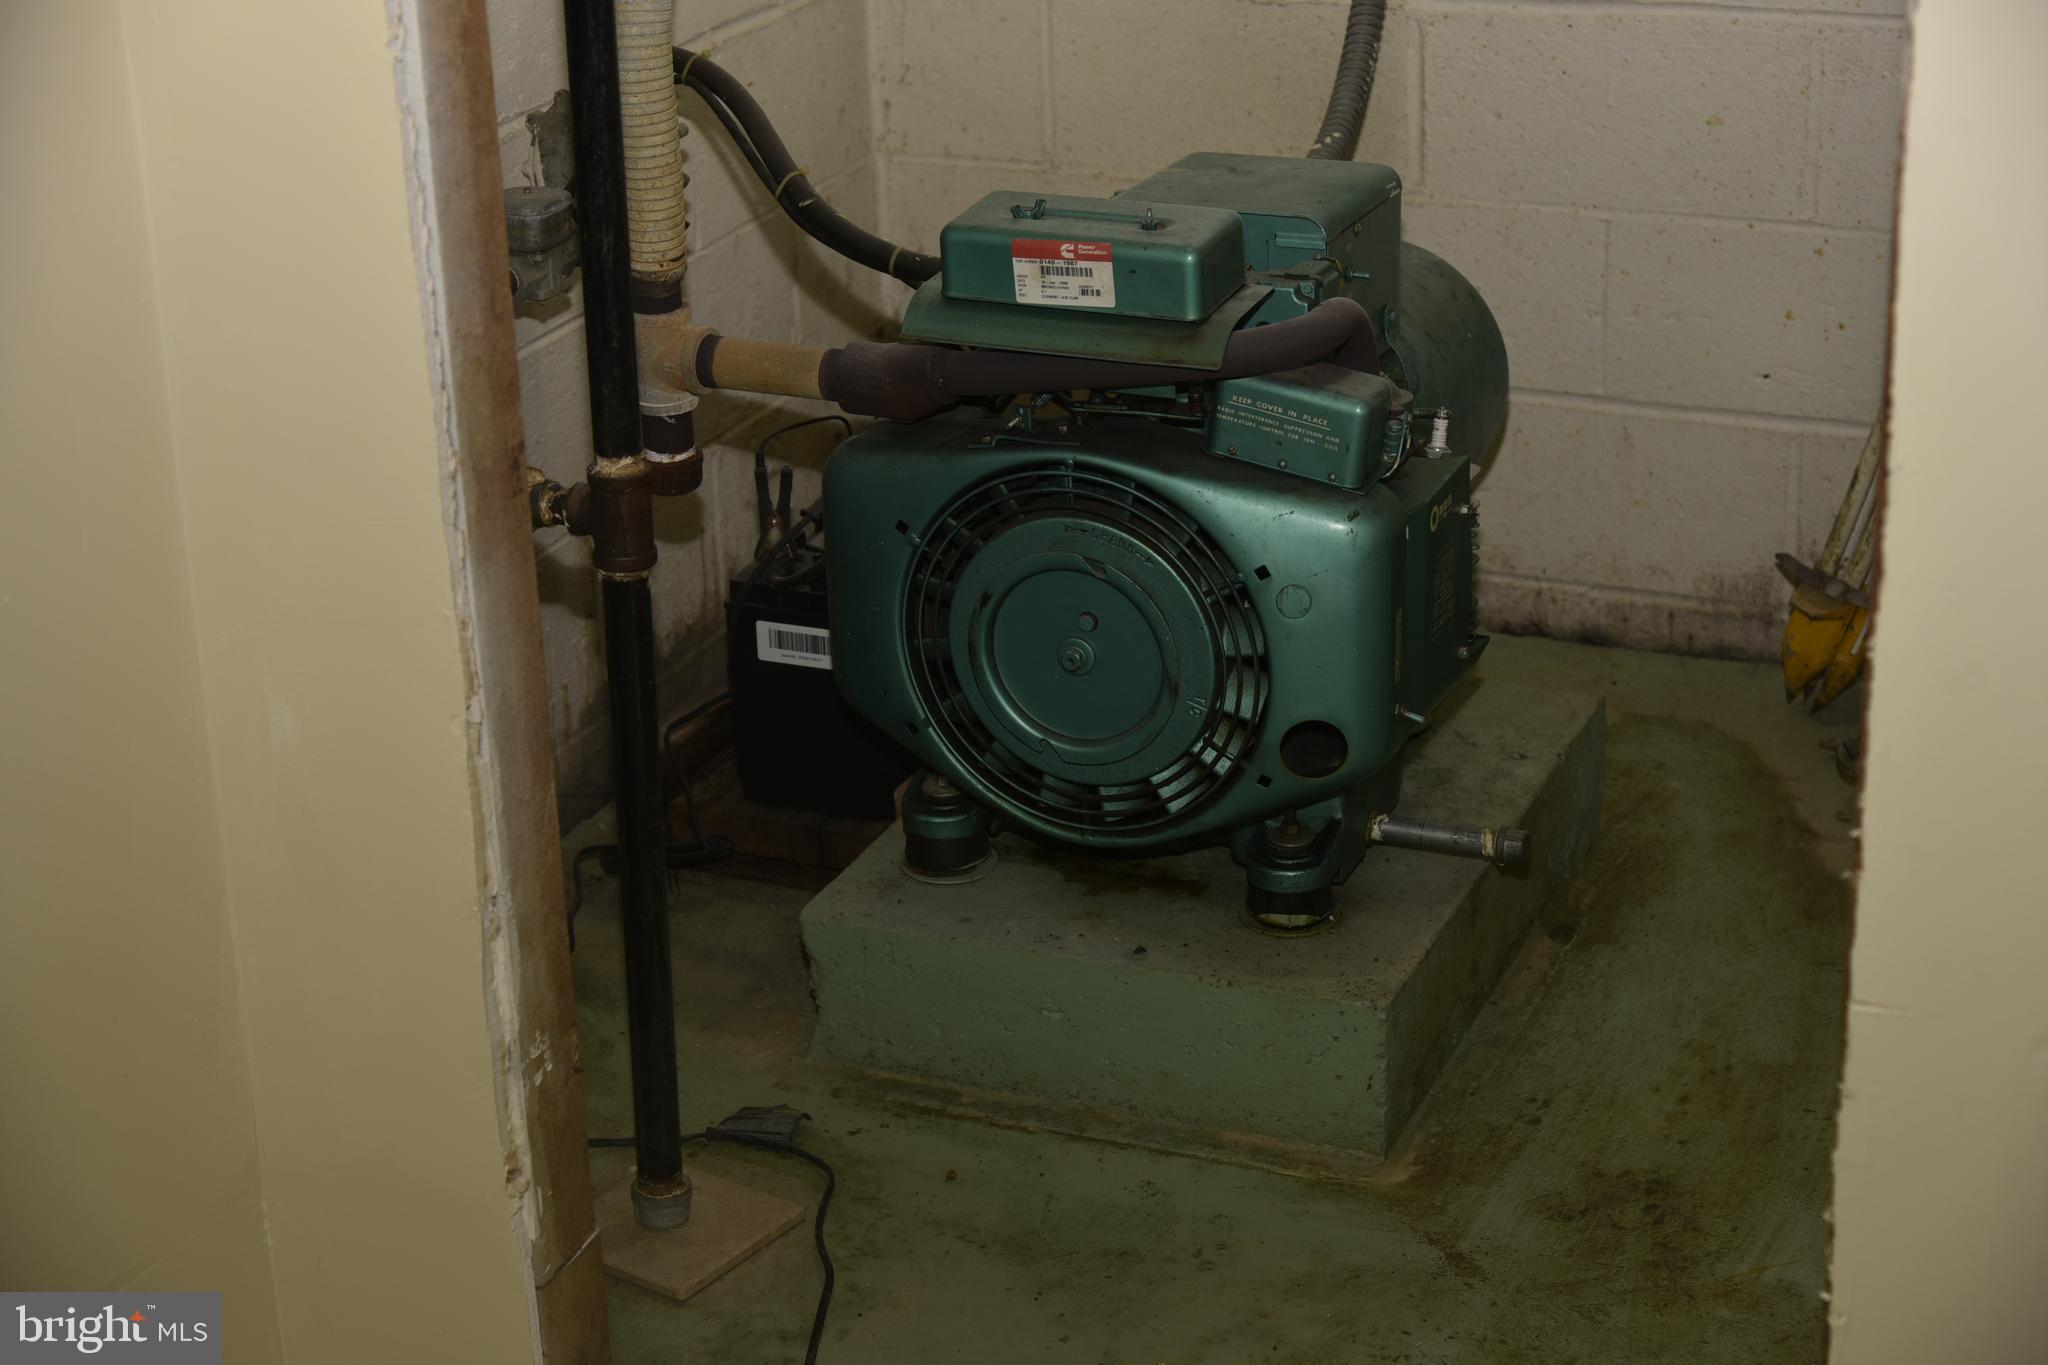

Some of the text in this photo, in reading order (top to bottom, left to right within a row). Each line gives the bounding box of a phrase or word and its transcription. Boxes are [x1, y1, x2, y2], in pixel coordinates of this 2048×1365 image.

[1216, 413, 1256, 428] TEMPERATURE
[1260, 426, 1285, 437] CONTROL
[1288, 432, 1299, 440] FOR
[1217, 405, 1340, 444] RADIO INTERFERENCE SUPPRESSION AND
[1232, 395, 1329, 427] KEEP COVER IN PLACE
